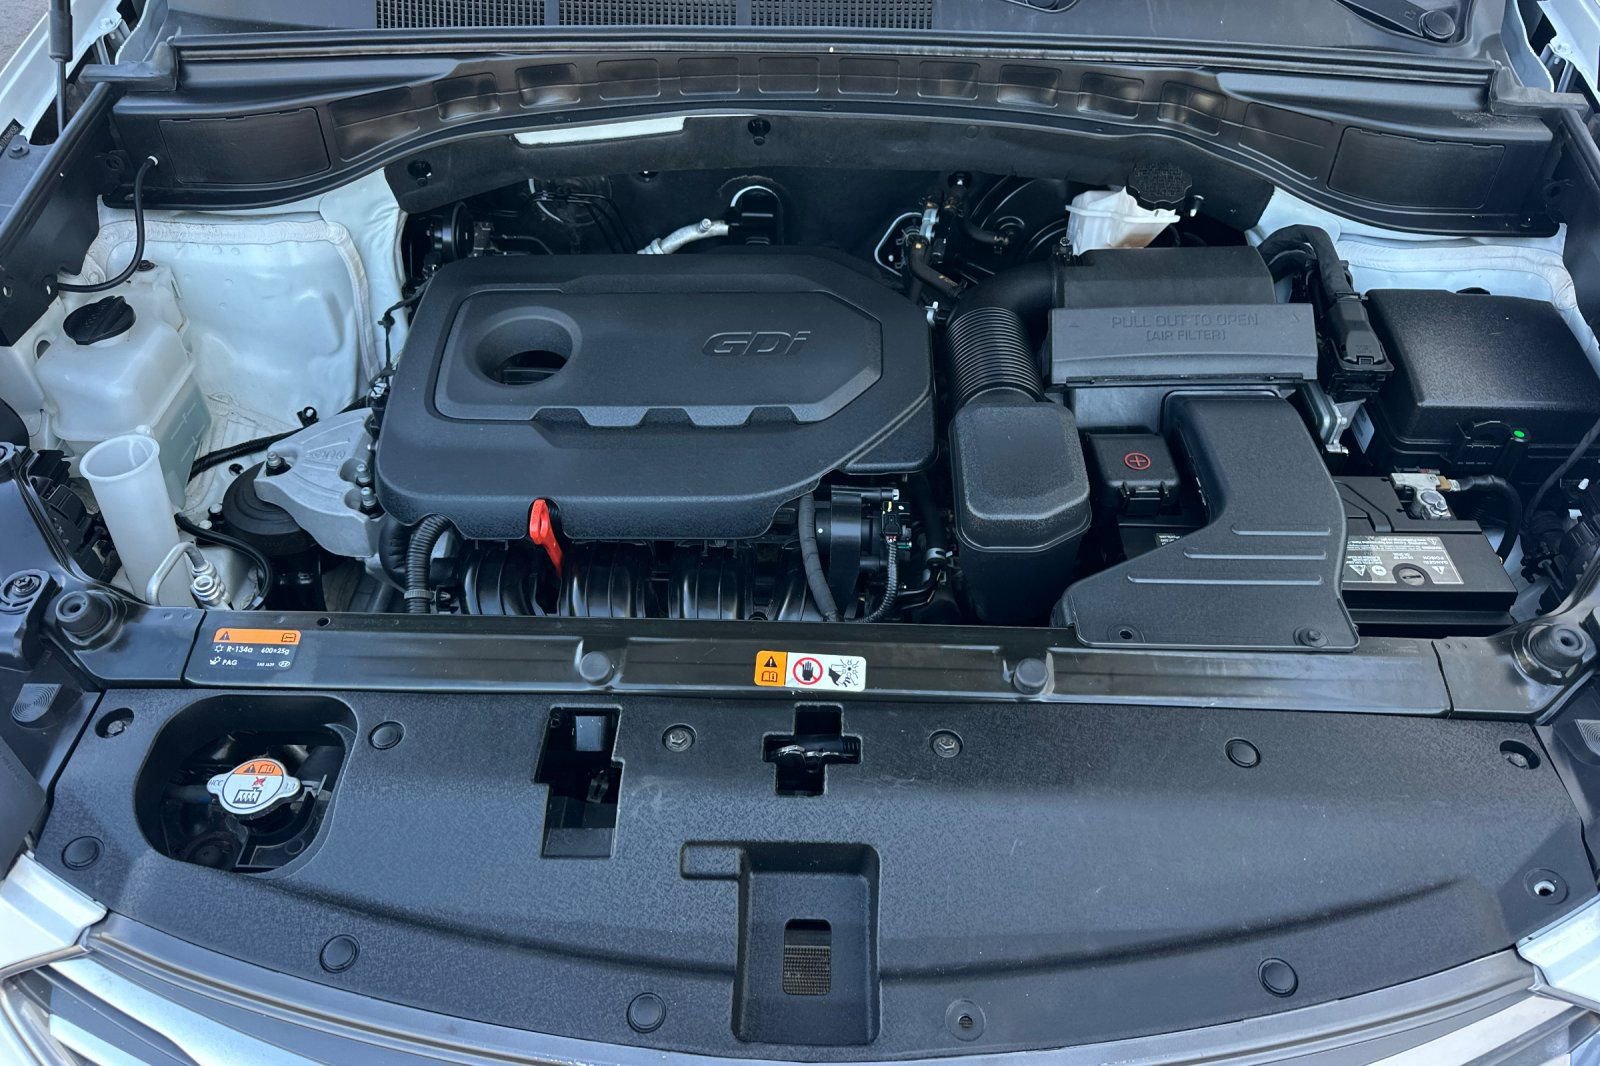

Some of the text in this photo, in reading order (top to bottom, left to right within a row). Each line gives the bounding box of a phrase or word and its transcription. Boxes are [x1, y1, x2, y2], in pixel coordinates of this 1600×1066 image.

[1111, 313, 1259, 328] PULL OUT TO OPEN
[226, 645, 254, 653] R-134a
